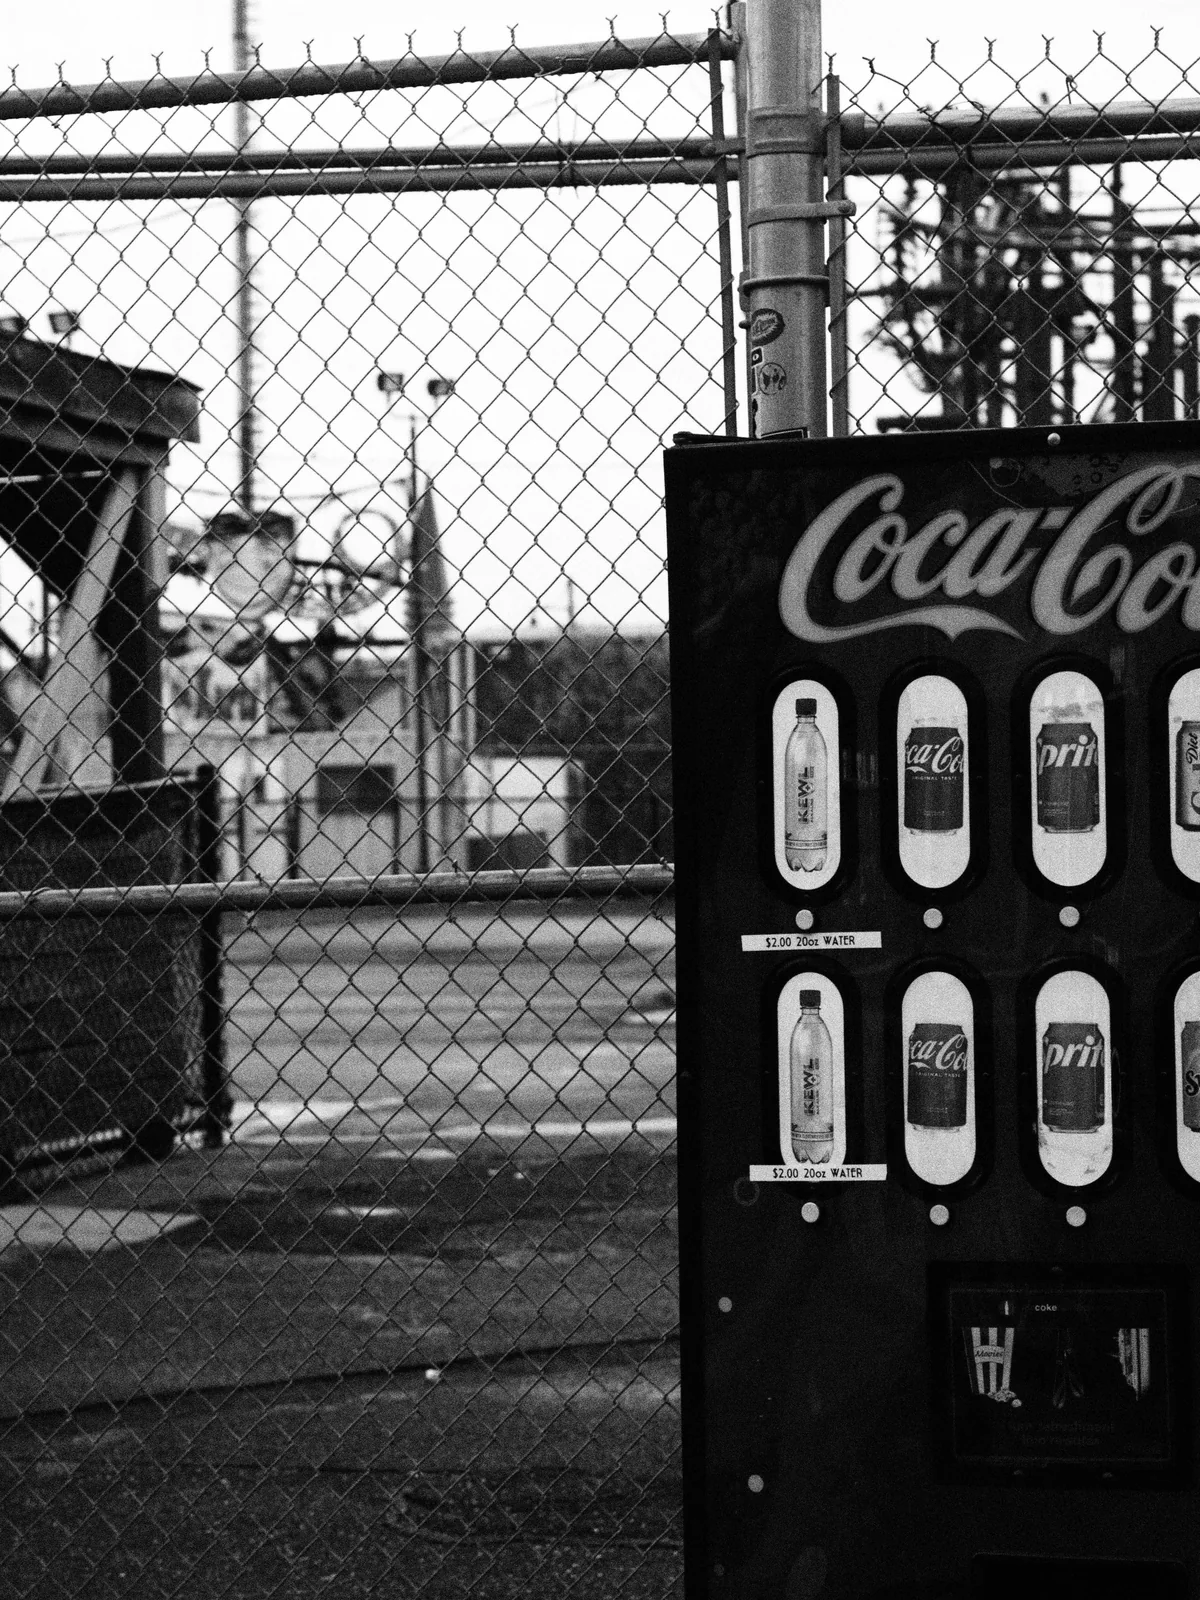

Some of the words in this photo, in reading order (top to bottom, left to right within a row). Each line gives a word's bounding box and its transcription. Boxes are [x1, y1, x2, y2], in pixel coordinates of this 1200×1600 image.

[905, 736, 964, 773] ca-Co
[1037, 734, 1098, 775] prit
[1186, 733, 1199, 764] Diet
[798, 767, 810, 824] KEWL
[766, 937, 791, 948] $2.00
[797, 936, 819, 947] 20oz
[823, 936, 855, 946] WATER
[909, 1034, 967, 1071] ca-Co
[1043, 1035, 1104, 1074] prit
[803, 1058, 815, 1116] KEWL
[773, 1168, 798, 1179] $2.00
[804, 1168, 826, 1179] 20oz
[831, 1168, 862, 1178] WATER
[1034, 1303, 1058, 1312] coke
